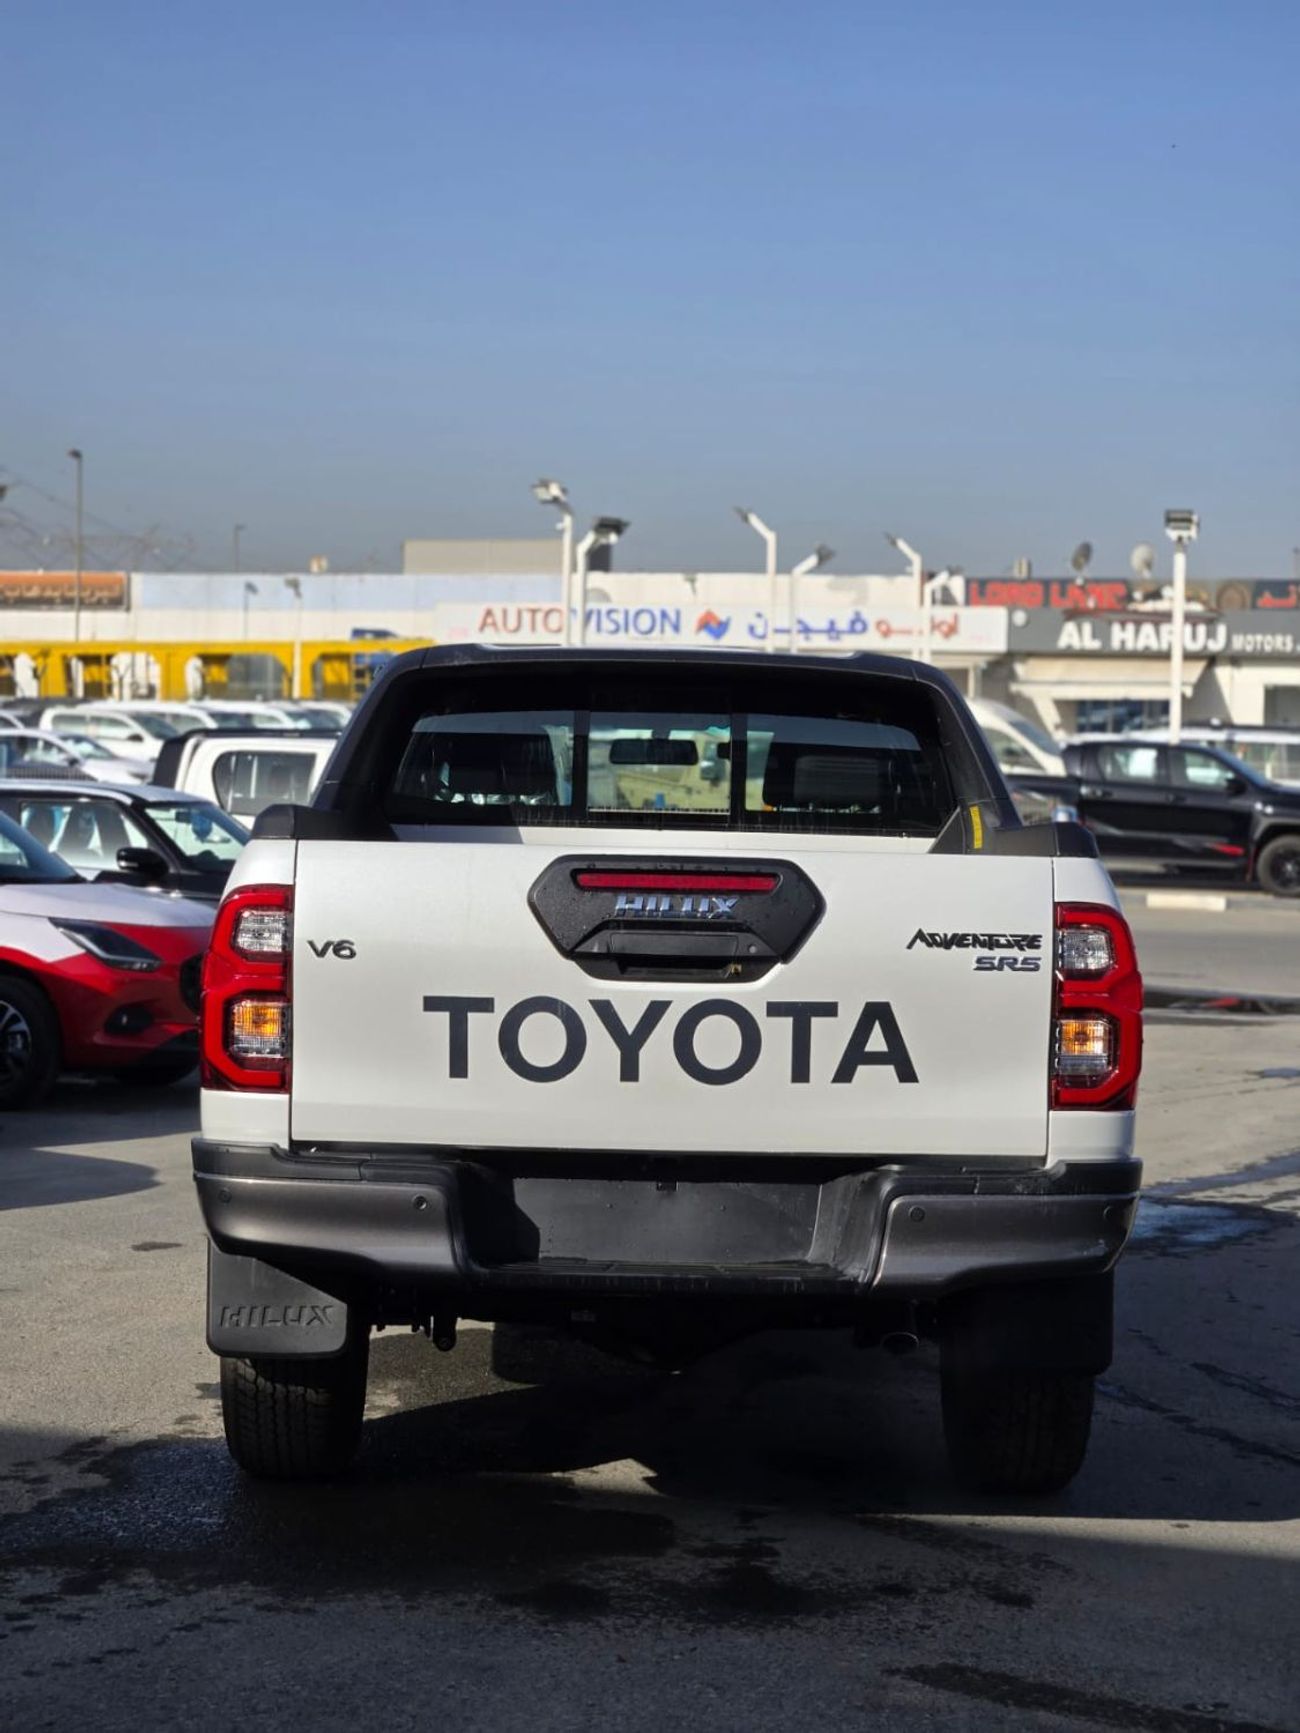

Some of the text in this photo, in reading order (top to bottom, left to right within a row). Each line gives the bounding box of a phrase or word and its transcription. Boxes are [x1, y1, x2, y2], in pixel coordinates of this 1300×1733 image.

[478, 607, 563, 634] AUTO
[1057, 621, 1101, 650] AL
[1231, 633, 1293, 653] MOTORS
[614, 895, 739, 918] HILUX
[307, 939, 357, 960] V6
[906, 927, 1043, 951] ADVENTURE
[422, 995, 919, 1086] TOYOTA
[219, 1304, 335, 1328] HILUX
